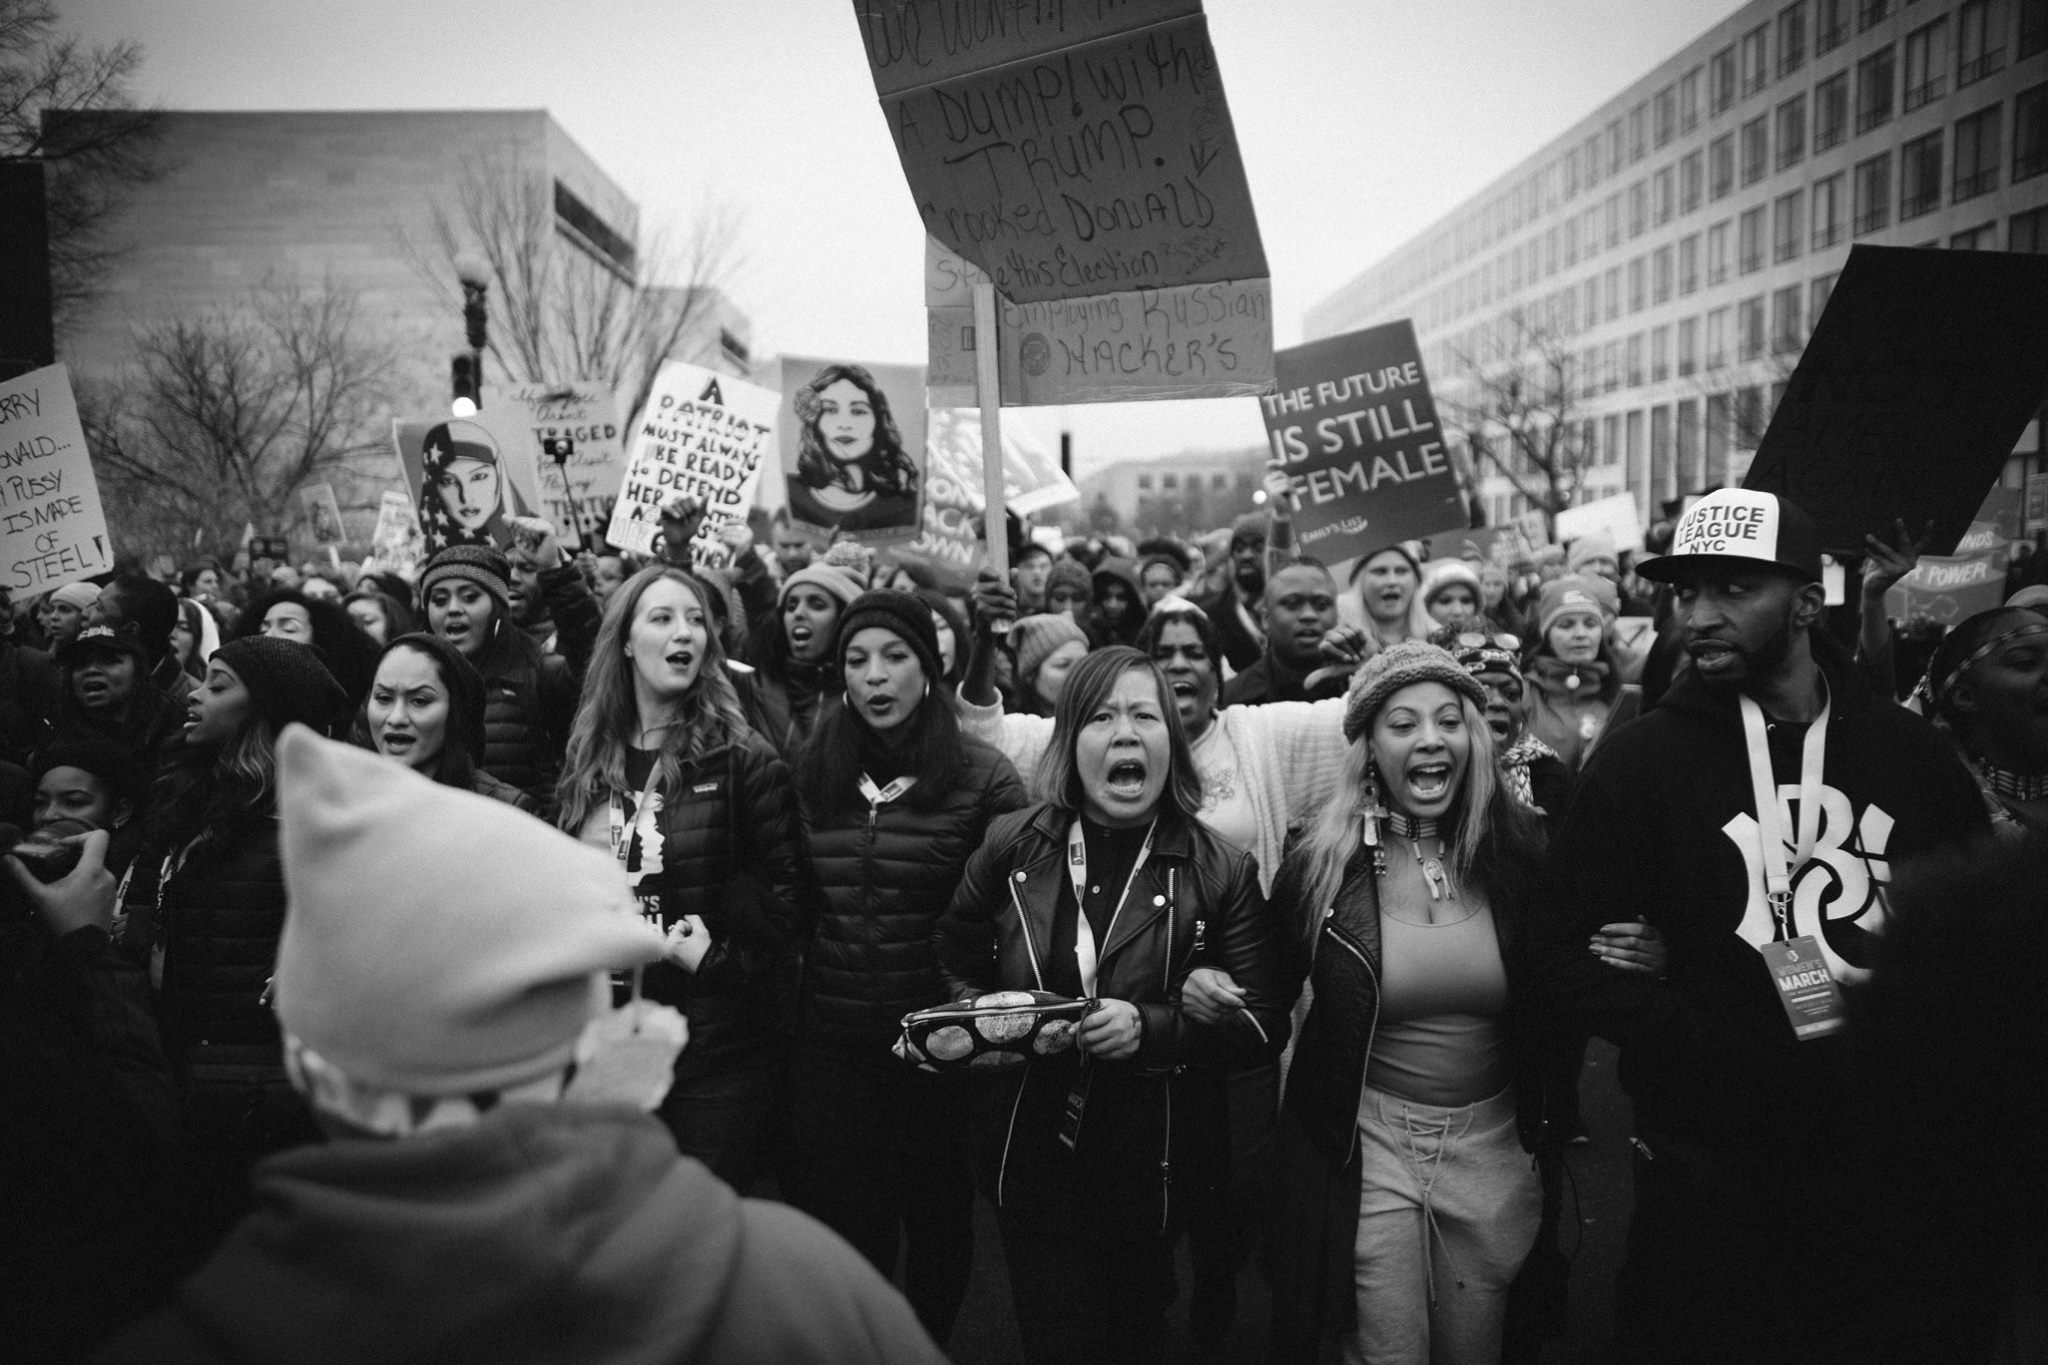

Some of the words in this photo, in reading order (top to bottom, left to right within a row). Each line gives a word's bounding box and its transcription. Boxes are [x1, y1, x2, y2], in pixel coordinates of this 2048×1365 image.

[699, 377, 724, 405] A
[1262, 387, 1314, 417] THE
[1316, 361, 1421, 406] FUTURE
[1270, 425, 1310, 463] IS
[1316, 399, 1434, 454] STILL
[642, 423, 693, 447] MUST
[697, 437, 761, 471] ALWAYS
[656, 445, 678, 465] BE
[686, 453, 749, 490] READY
[1289, 442, 1448, 512] FEMALE
[6, 469, 62, 500] PUSSY
[658, 468, 743, 505] DEFEND
[1680, 505, 1765, 532] JUSTICE
[35, 530, 59, 552] OF
[1678, 522, 1759, 548] LEAGUE
[1689, 539, 1726, 555] NYC
[1928, 562, 1988, 586] POWER
[1777, 968, 1830, 992] MARCH
